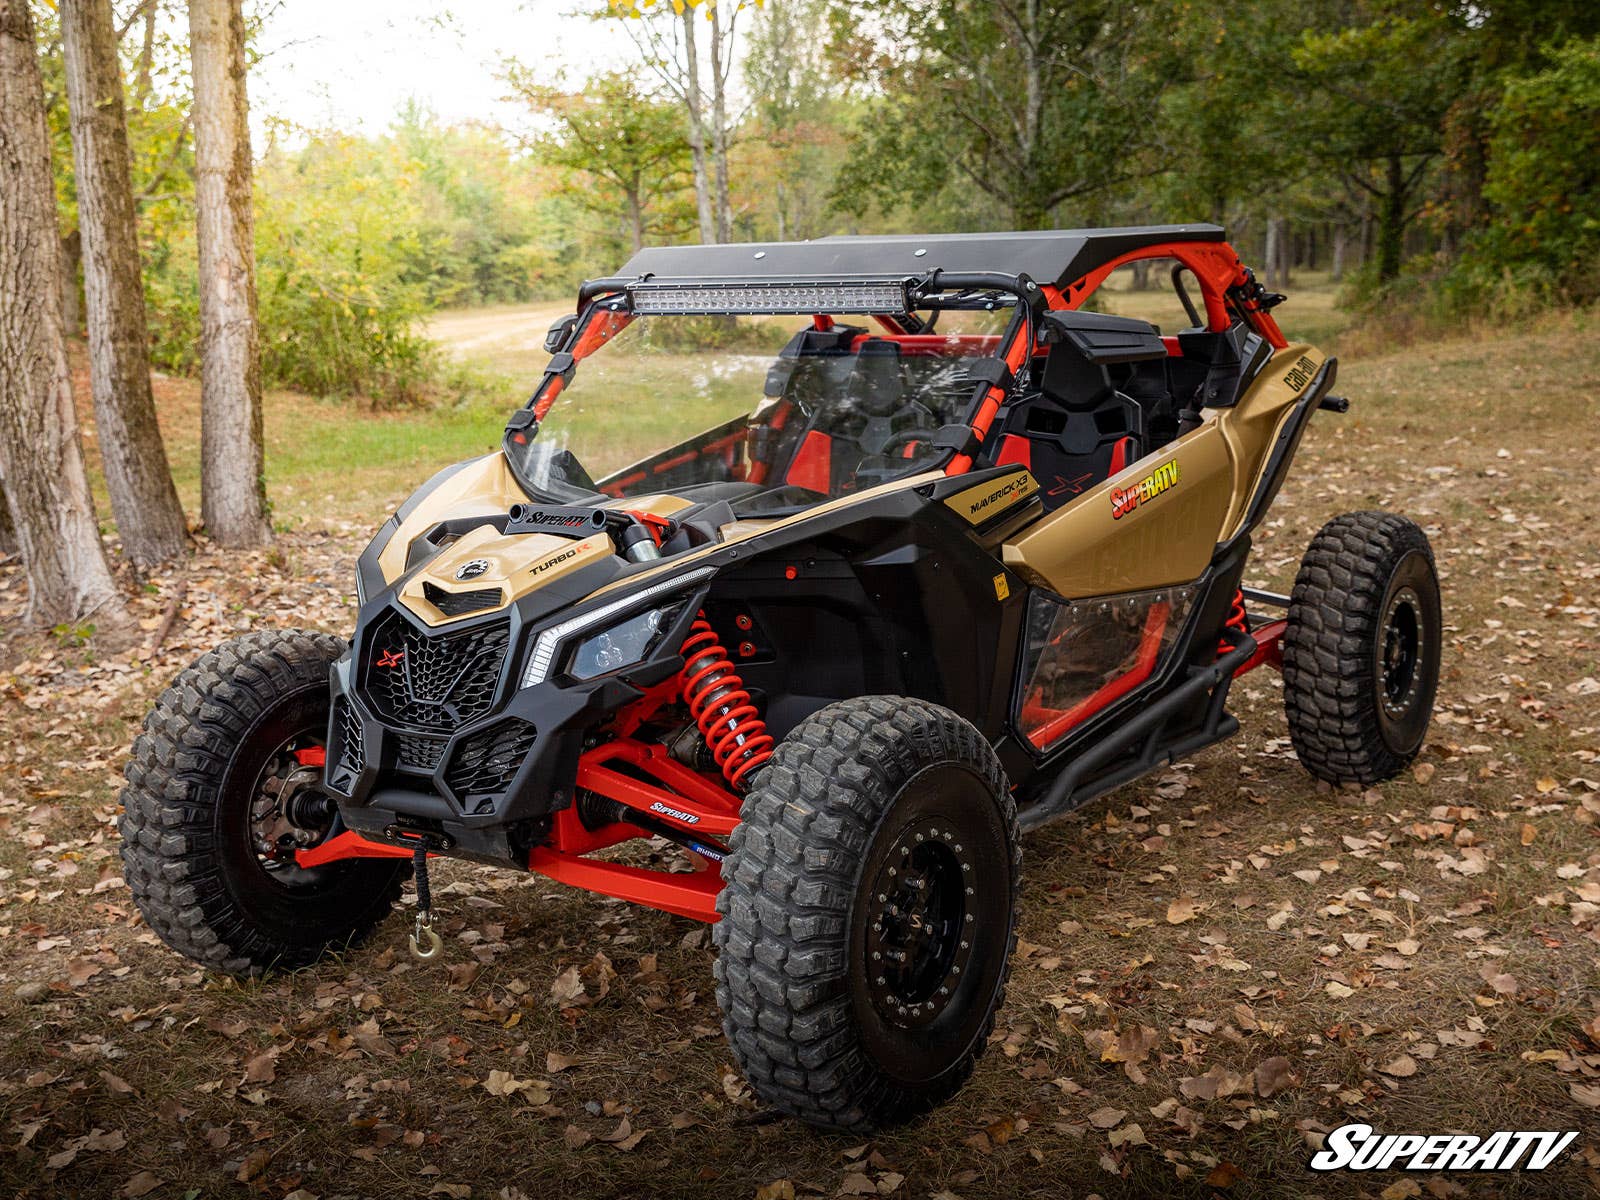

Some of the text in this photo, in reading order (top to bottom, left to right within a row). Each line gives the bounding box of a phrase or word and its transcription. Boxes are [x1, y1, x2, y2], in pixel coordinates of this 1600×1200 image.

[969, 482, 1016, 514] MAVERICK
[1110, 458, 1178, 520] SUPERATV
[526, 511, 590, 527] SUPERATV
[529, 549, 577, 576] TURBO
[649, 801, 700, 825] SUPERATV
